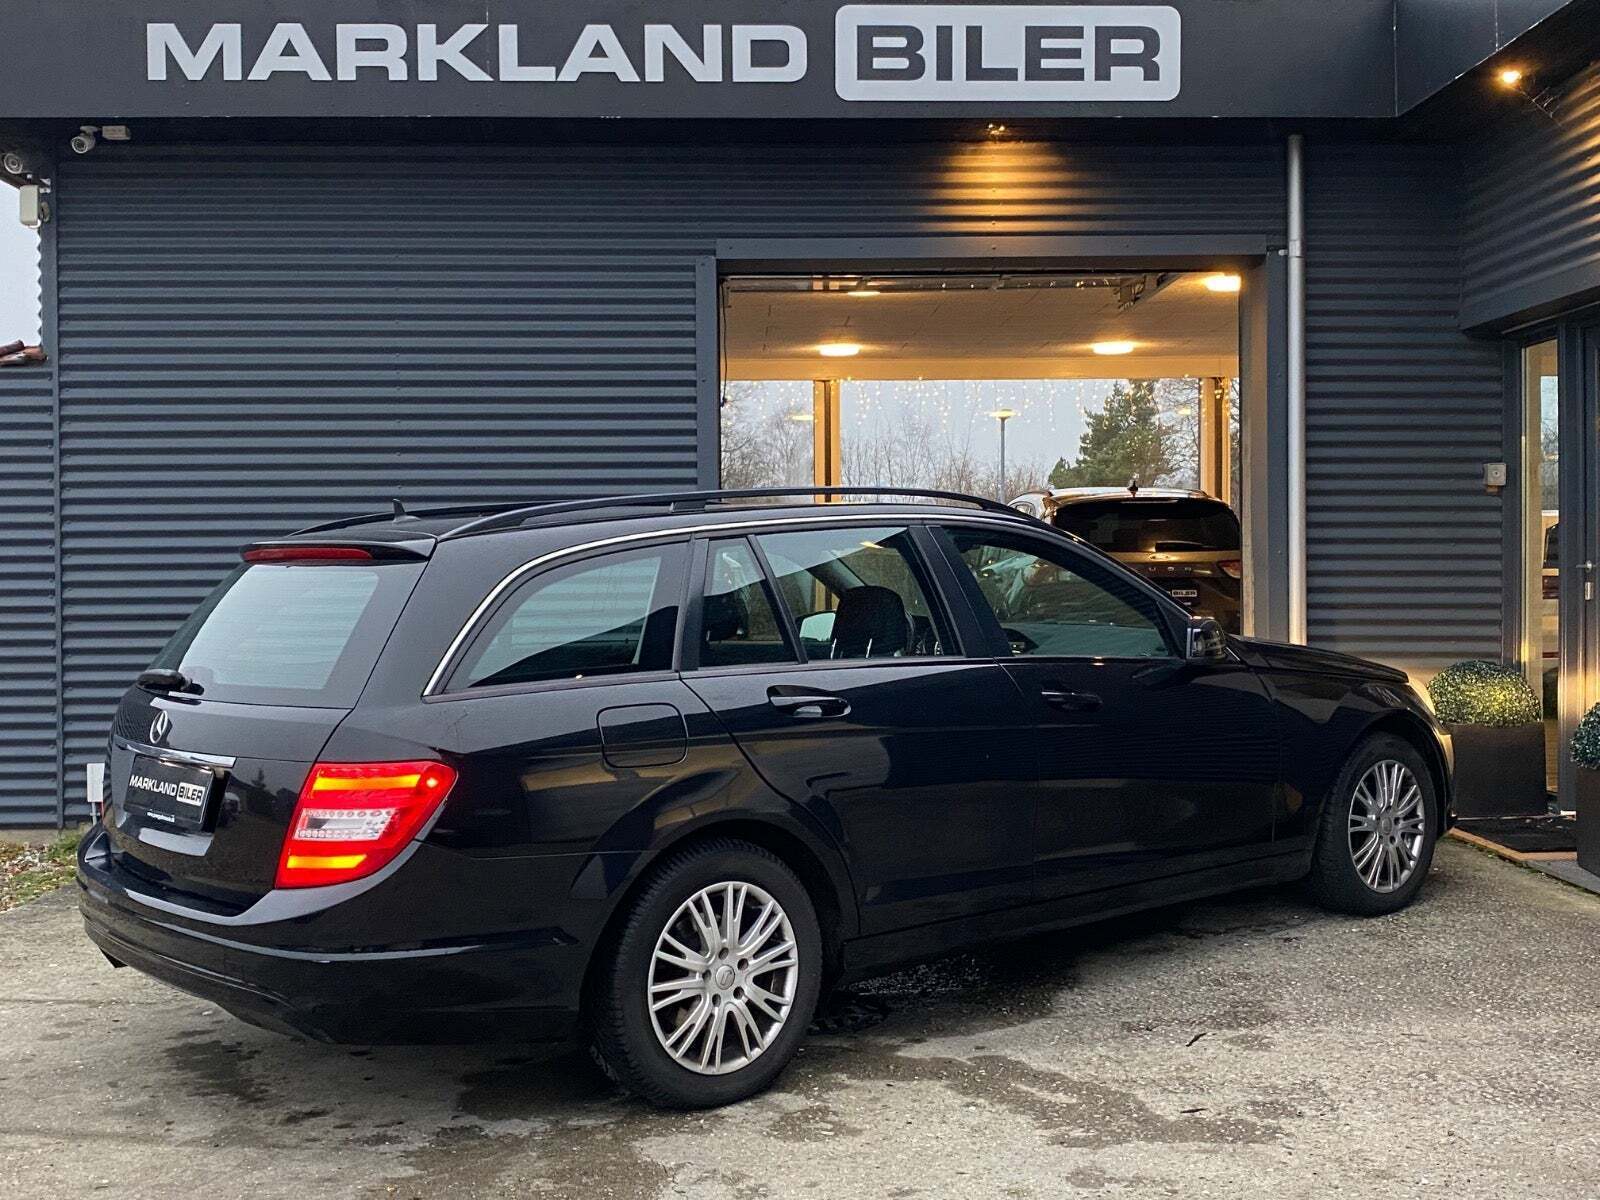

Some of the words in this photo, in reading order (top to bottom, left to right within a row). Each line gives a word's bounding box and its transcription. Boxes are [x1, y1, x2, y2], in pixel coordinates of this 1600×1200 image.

[147, 23, 807, 82] MARKLAND
[857, 24, 1161, 82] BILER
[129, 774, 177, 796] MARKLAND
[178, 785, 204, 803] BILER
